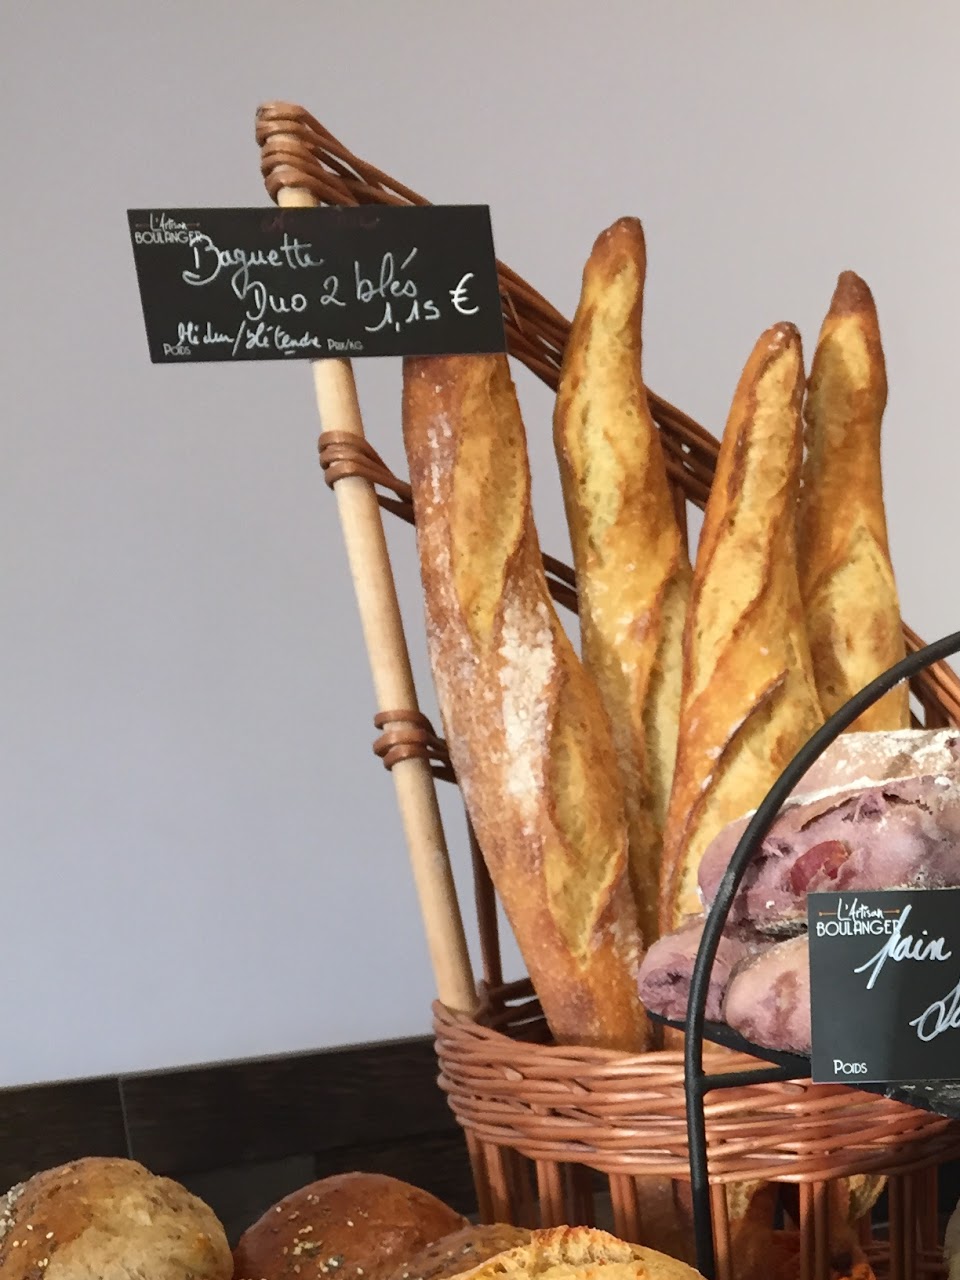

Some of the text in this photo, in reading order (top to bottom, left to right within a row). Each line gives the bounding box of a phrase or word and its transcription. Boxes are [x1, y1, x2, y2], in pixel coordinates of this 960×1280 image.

[150, 212, 188, 231] L'Artisan
[182, 232, 323, 299] Baguette
[245, 246, 417, 320] Duo 2 blés
[448, 272, 480, 315] €
[837, 897, 885, 922] L'Artisan
[815, 918, 901, 937] BOULANGER
